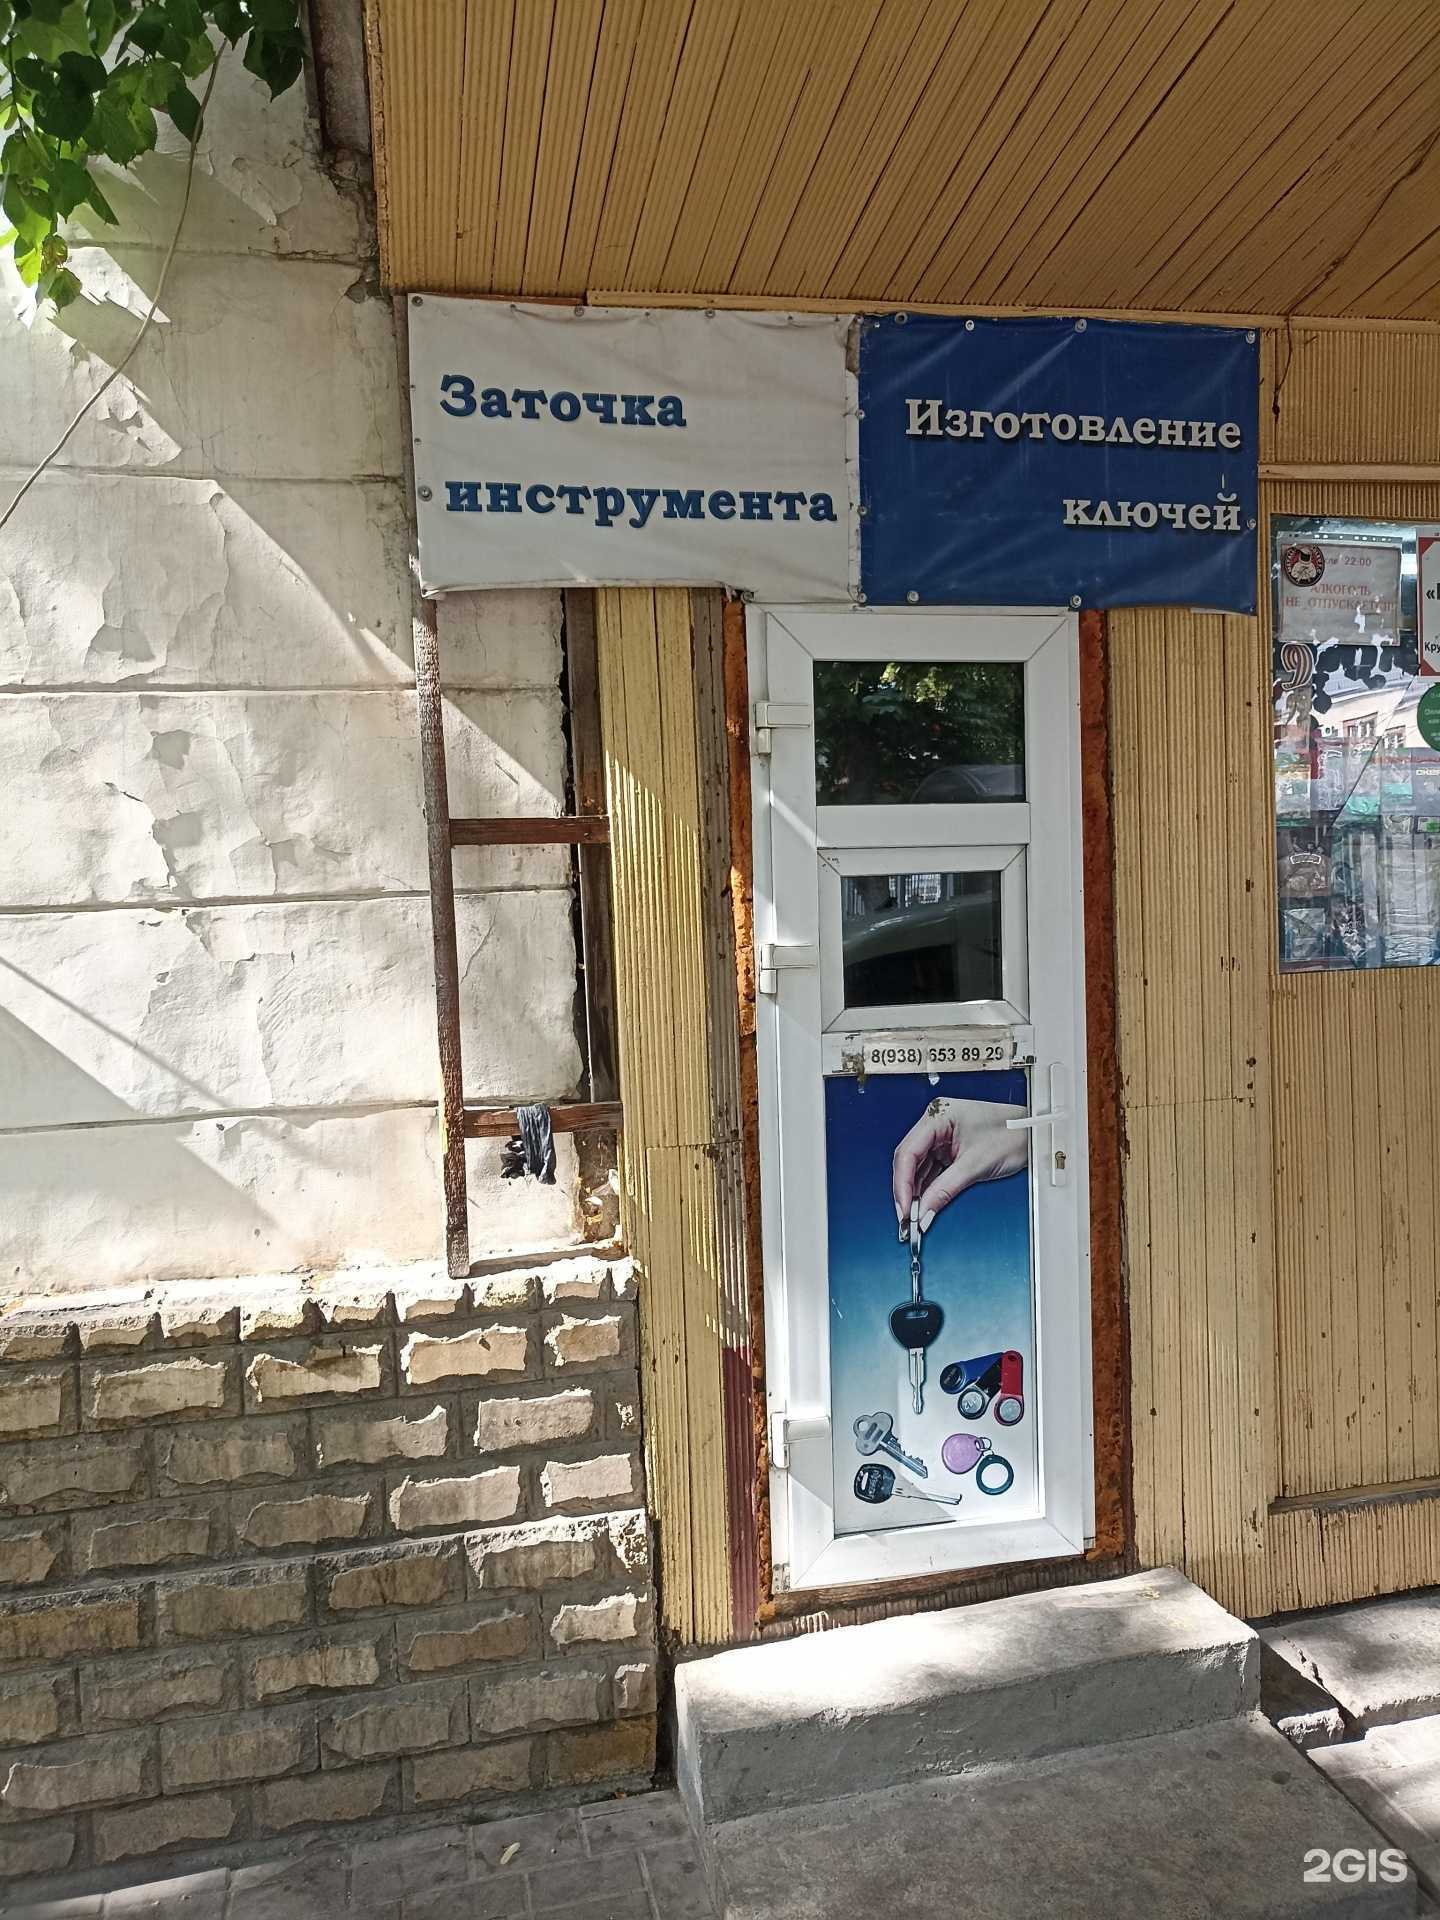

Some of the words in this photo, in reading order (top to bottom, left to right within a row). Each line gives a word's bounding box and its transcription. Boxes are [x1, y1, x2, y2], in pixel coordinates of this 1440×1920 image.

[439, 374, 687, 427] Заточка
[905, 398, 1241, 449] Изготовление
[445, 480, 837, 529] инструмента
[1062, 492, 1241, 531] ключей
[871, 1048, 922, 1066] 8(938)
[929, 1047, 956, 1062] 653
[961, 1047, 980, 1062] 89
[985, 1046, 1004, 1061] 29
